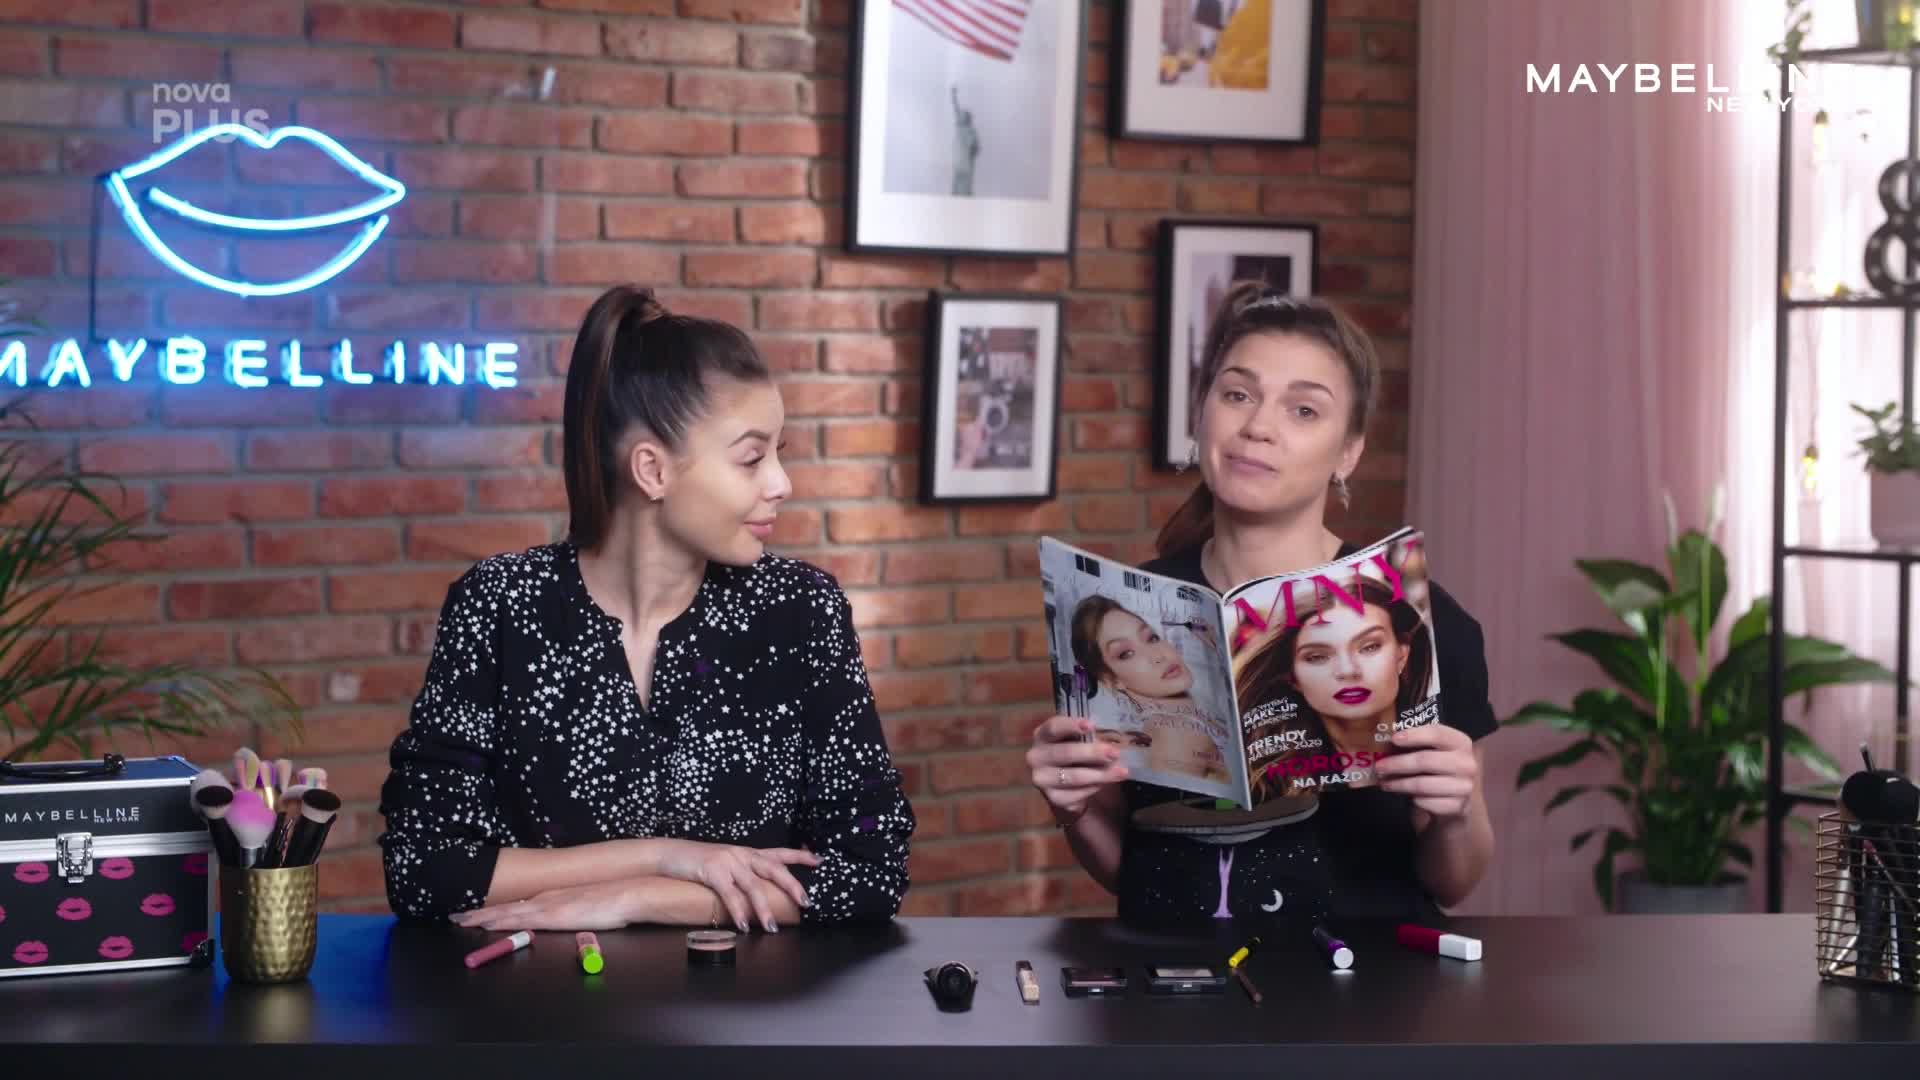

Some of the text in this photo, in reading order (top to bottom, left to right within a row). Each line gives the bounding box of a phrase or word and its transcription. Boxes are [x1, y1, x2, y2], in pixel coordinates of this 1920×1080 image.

[1233, 539, 1420, 650] MNY
[1247, 729, 1307, 755] TRENDY
[1293, 776, 1317, 789] NA
[4, 806, 140, 823] MAYBELLINE
[93, 815, 140, 824] NEW YORK
